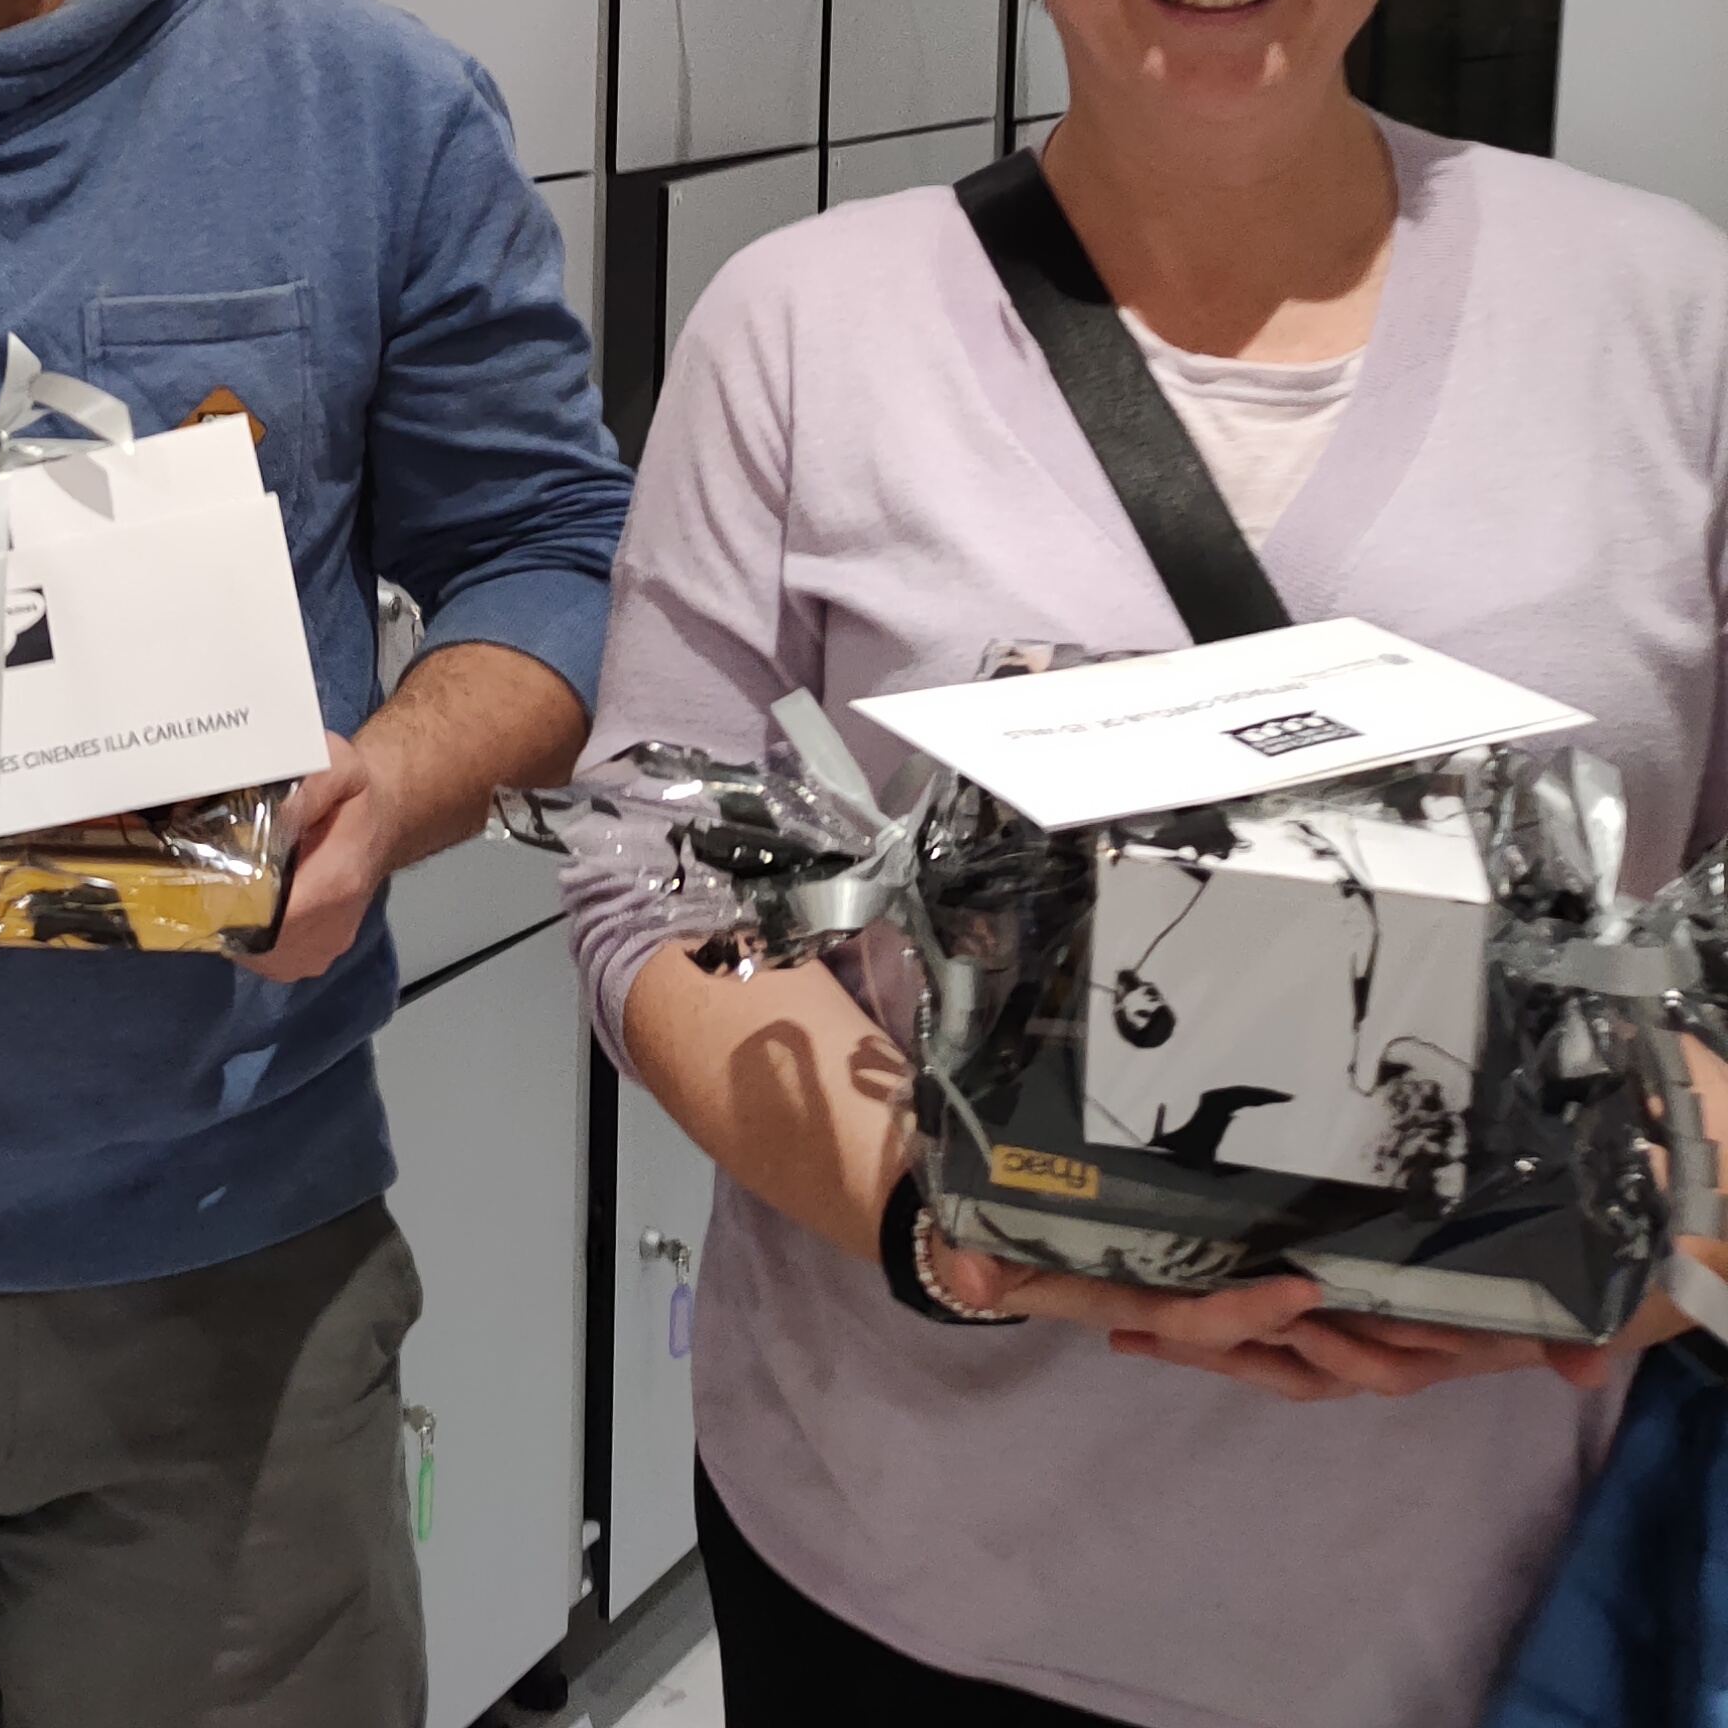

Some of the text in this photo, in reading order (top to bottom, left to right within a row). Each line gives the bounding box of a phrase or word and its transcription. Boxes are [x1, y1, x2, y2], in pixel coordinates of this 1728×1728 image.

[22, 737, 101, 770] CINEMES
[104, 730, 140, 754] ILLA
[143, 706, 251, 746] CARLEMANY
